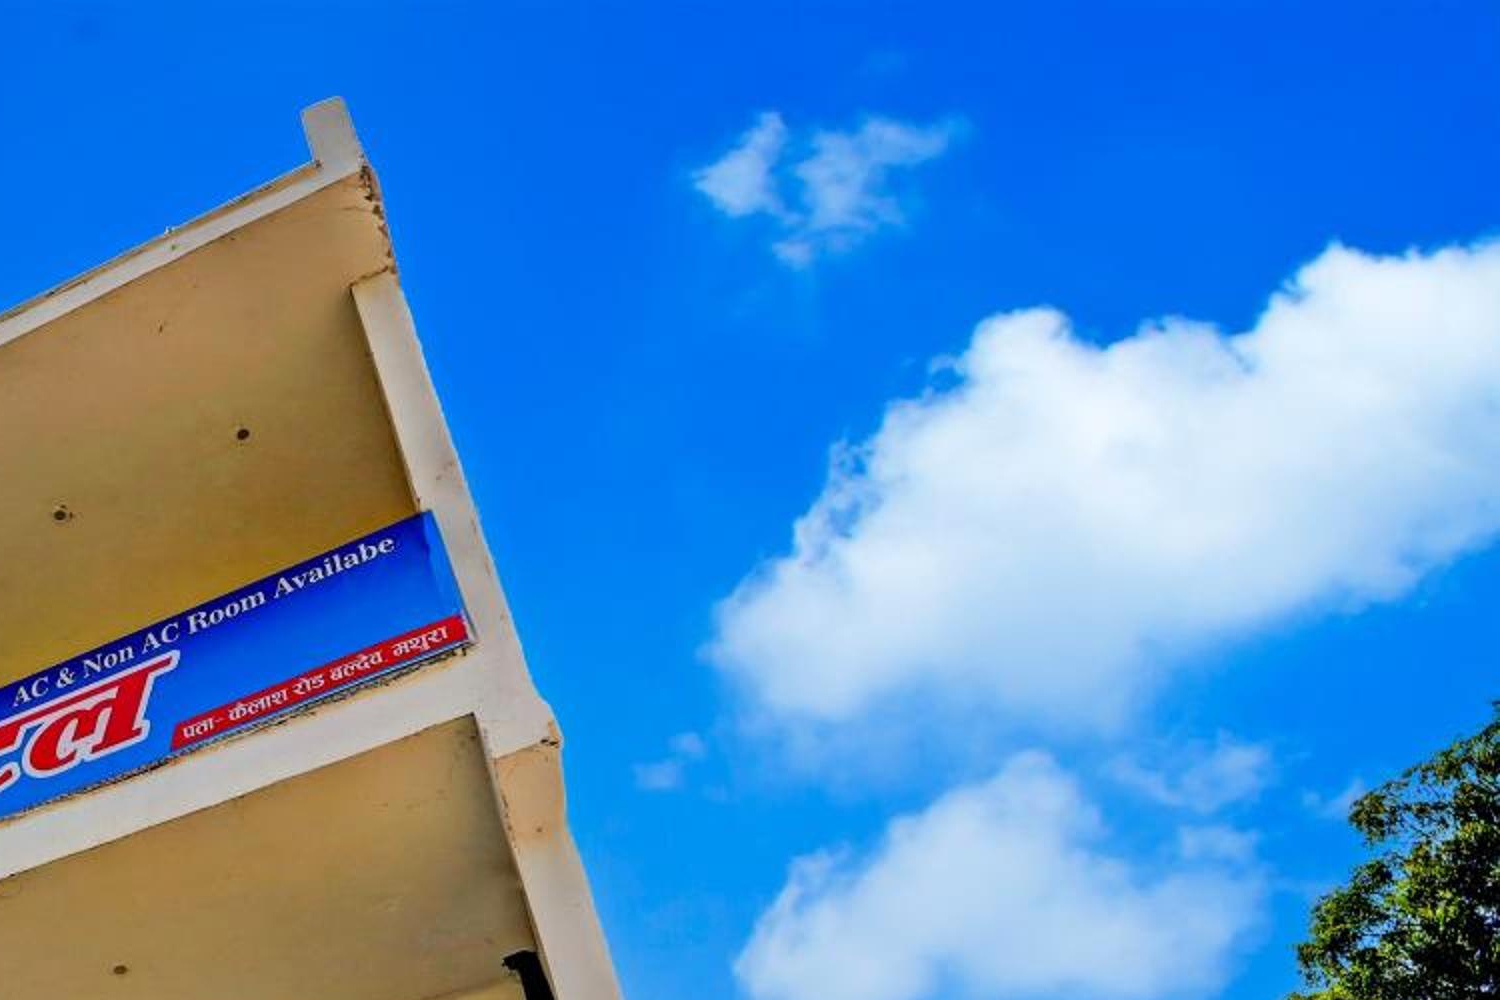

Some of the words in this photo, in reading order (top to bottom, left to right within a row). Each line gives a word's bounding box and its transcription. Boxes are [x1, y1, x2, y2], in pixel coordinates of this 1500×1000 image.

[11, 676, 51, 708] AC
[55, 666, 76, 690] &
[82, 642, 135, 680] Non
[141, 622, 181, 655] AC
[186, 590, 267, 636] Room
[272, 536, 395, 600] Availabe
[292, 674, 325, 695] रोड
